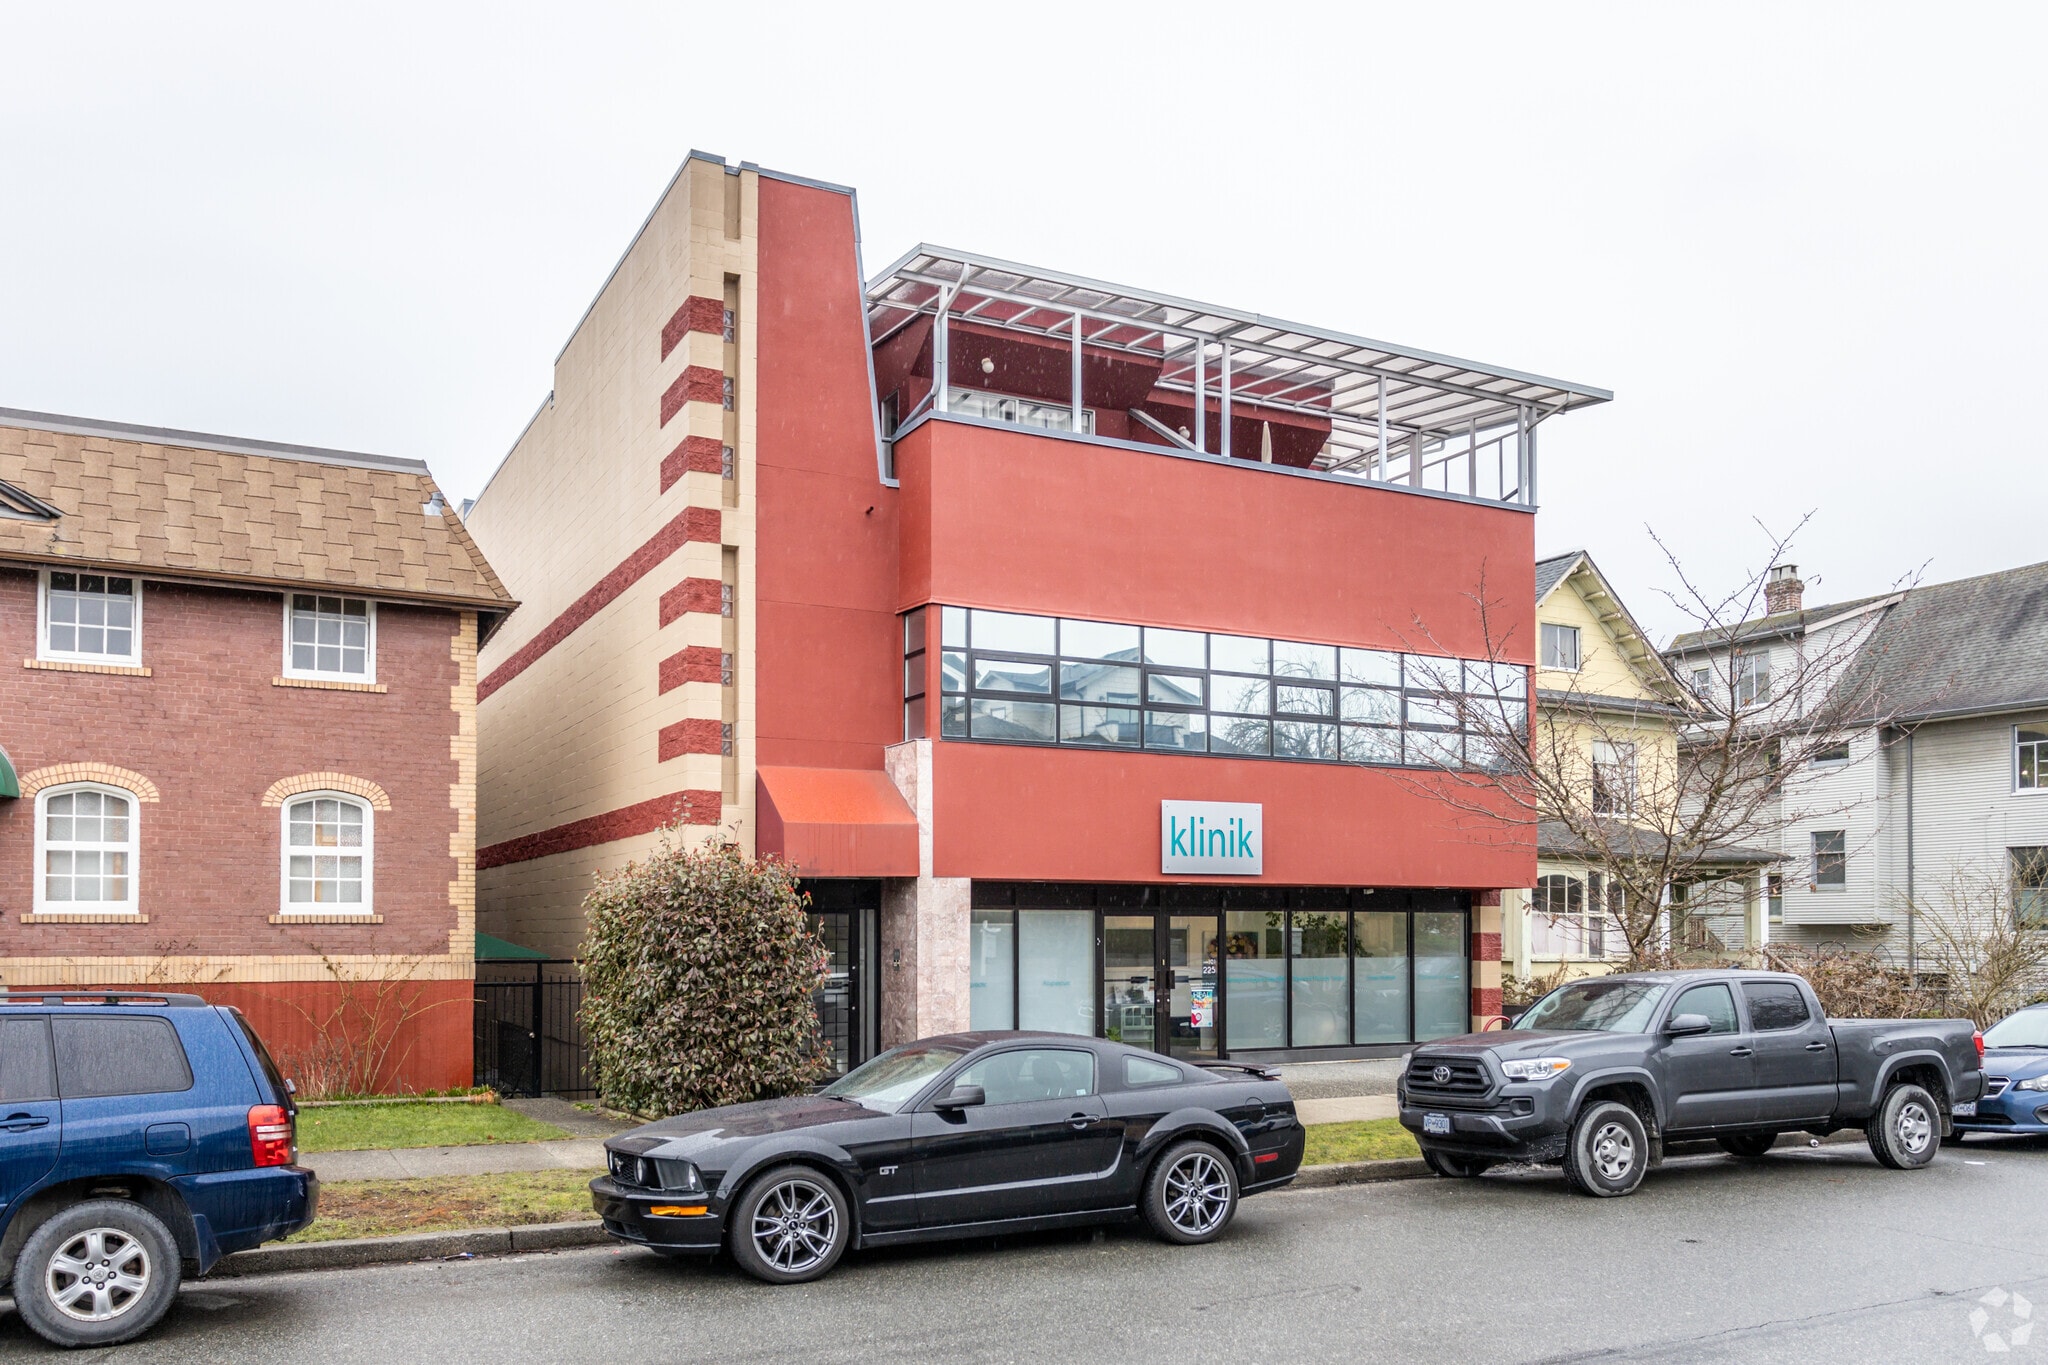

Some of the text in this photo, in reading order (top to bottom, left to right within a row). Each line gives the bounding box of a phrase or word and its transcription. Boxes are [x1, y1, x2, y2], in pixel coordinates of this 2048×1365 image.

[1171, 816, 1254, 858] klinik
[1203, 966, 1216, 974] 225
[879, 1165, 899, 1176] GT
